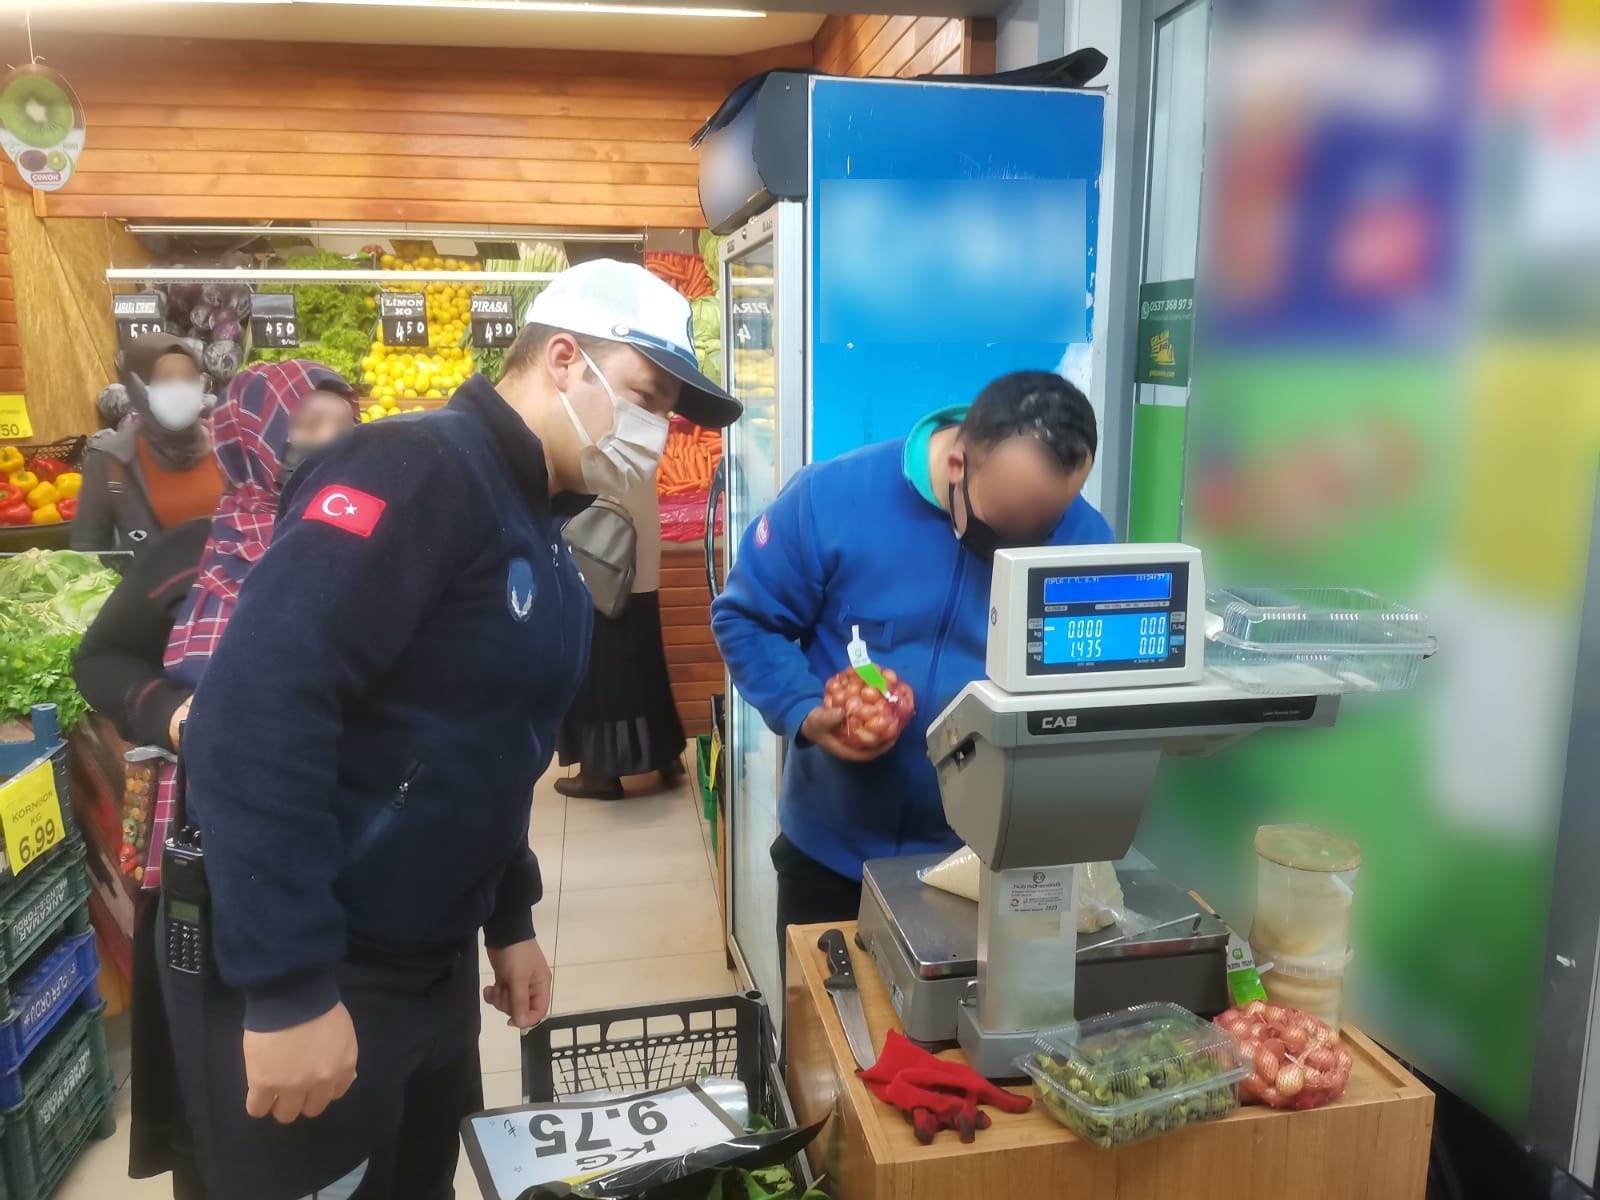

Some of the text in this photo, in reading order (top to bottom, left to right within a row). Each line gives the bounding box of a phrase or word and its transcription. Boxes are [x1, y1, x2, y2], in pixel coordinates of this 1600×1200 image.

[470, 301, 508, 313] PIRASA
[1042, 715, 1078, 729] CAS
[19, 818, 55, 863] 6.99
[528, 1100, 668, 1158] 9.75
